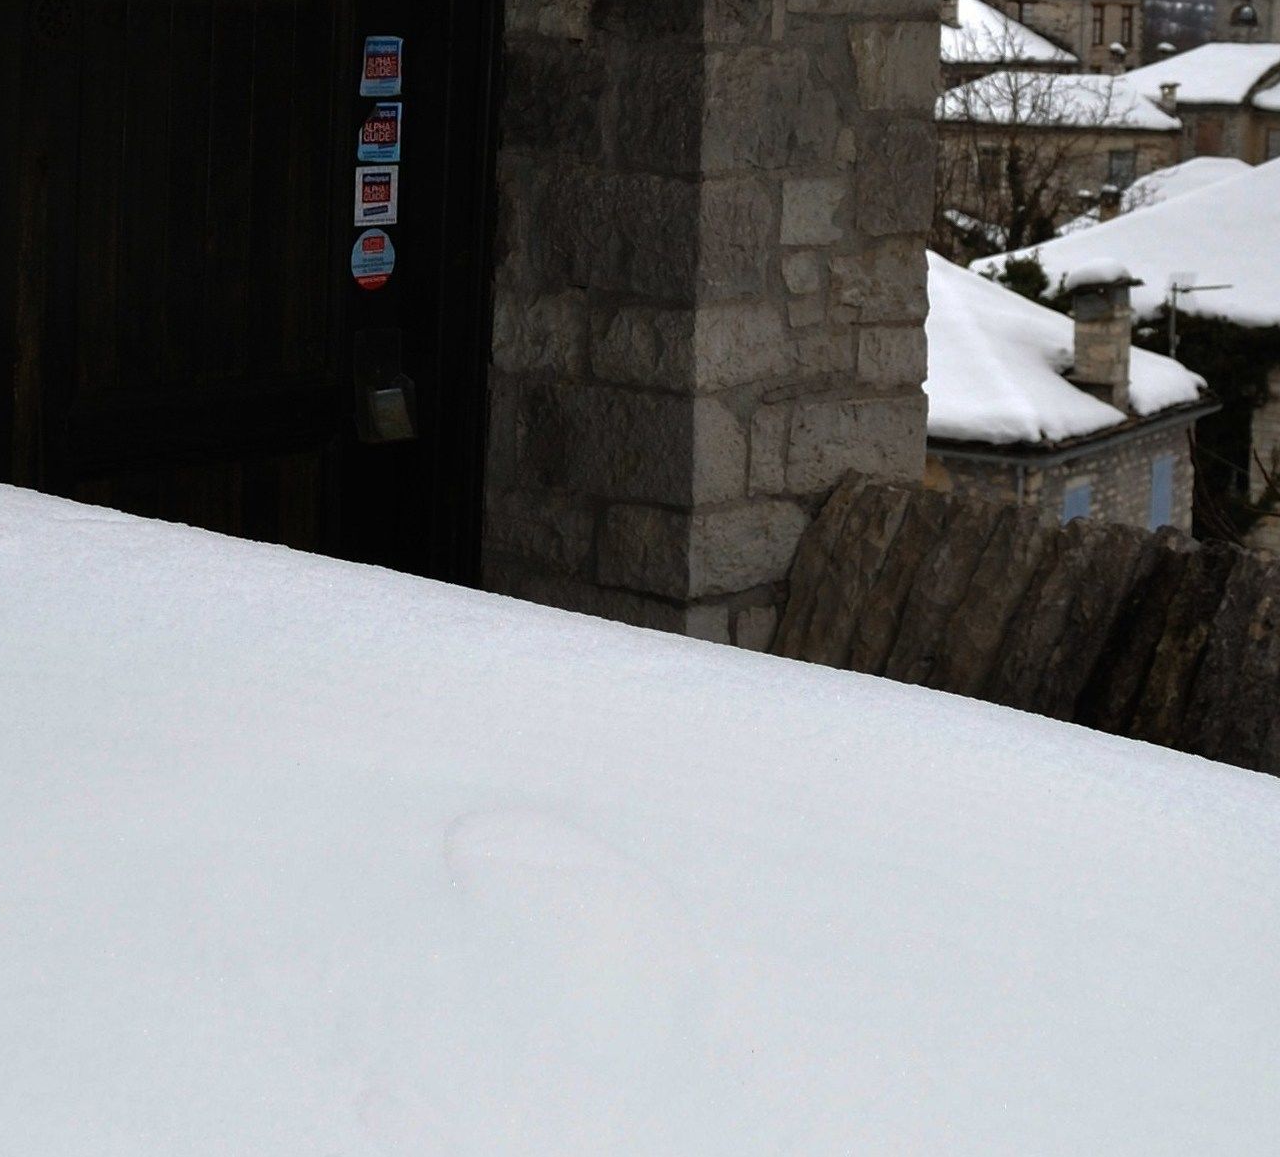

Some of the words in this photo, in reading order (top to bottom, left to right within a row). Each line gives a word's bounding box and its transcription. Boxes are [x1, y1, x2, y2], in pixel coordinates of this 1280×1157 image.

[367, 56, 392, 66] ALPHA
[367, 66, 392, 76] GUIDE
[365, 122, 390, 132] ALPHA
[364, 132, 390, 142] GUIDE
